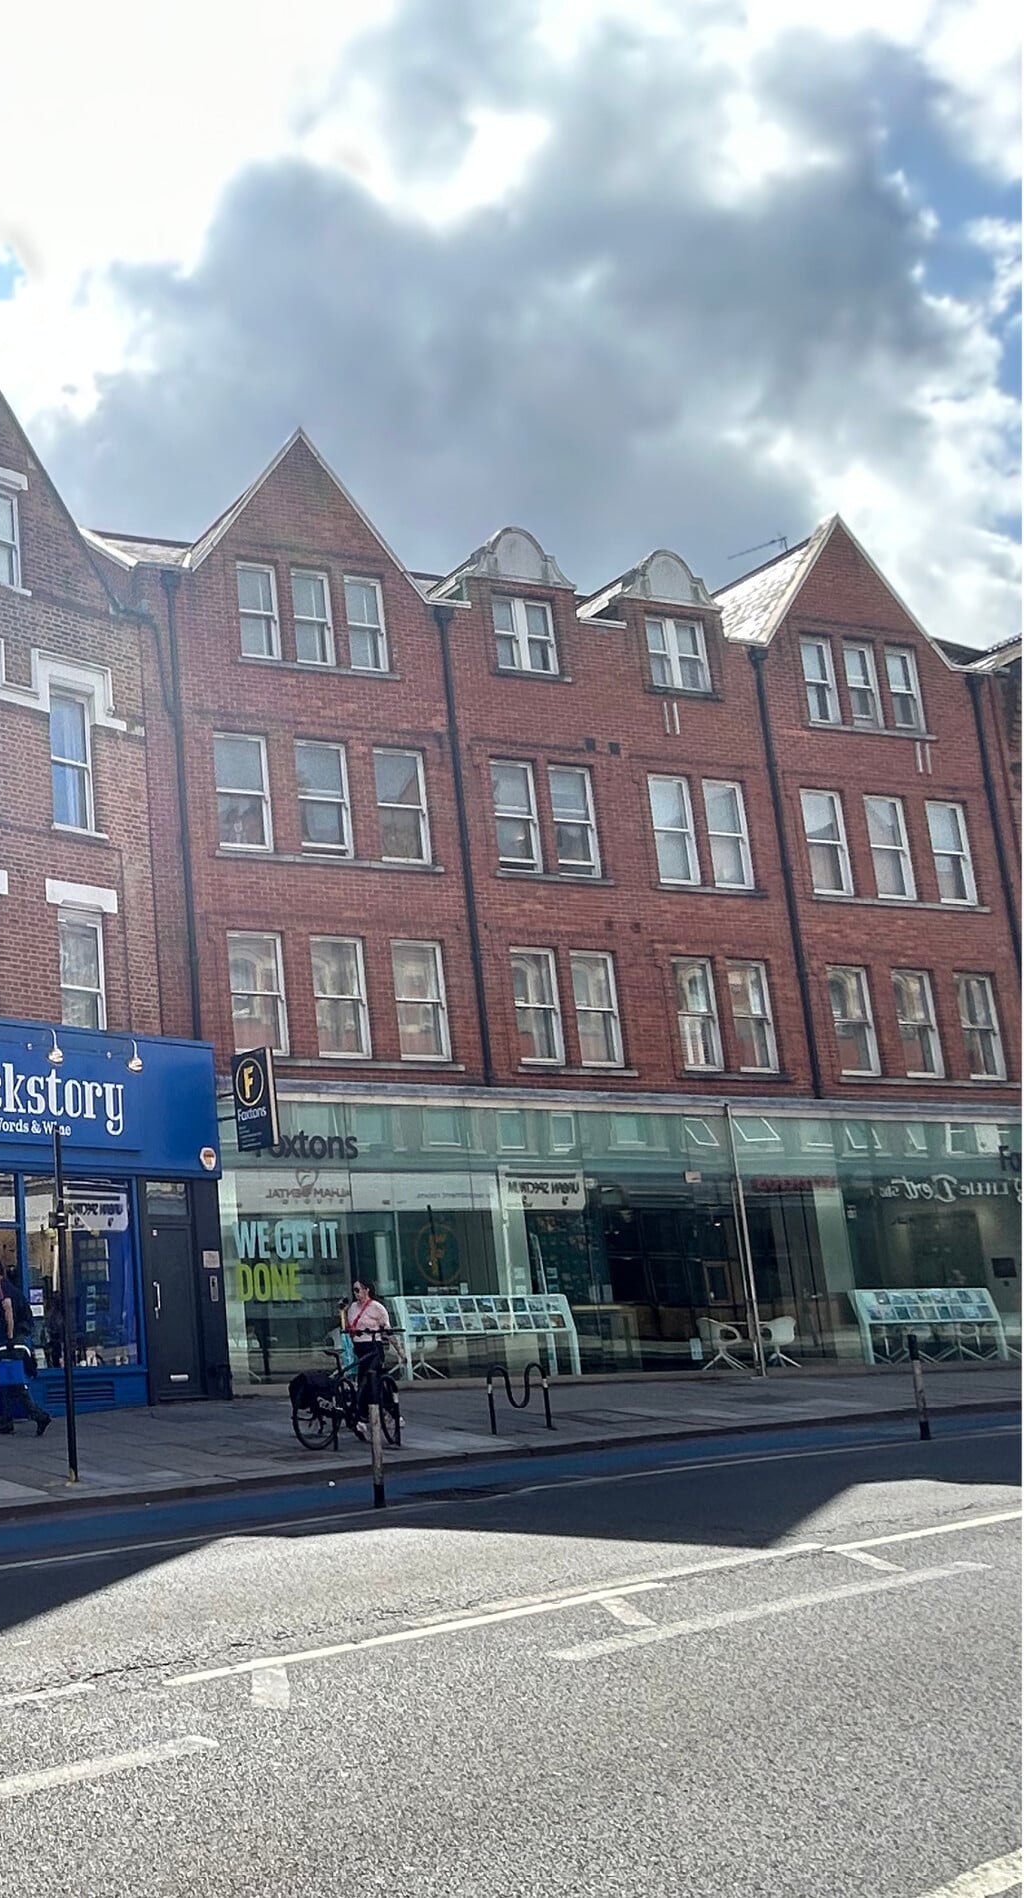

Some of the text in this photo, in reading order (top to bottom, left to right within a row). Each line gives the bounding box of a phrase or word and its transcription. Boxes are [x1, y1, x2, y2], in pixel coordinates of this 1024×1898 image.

[243, 1066, 255, 1100] F
[31, 1119, 42, 1134] &
[42, 1120, 72, 1136] Wne
[237, 1107, 267, 1122] Foxtons
[256, 1130, 359, 1160] oxtons
[233, 1219, 339, 1259] WE GET IT
[236, 1262, 303, 1302] DONE
